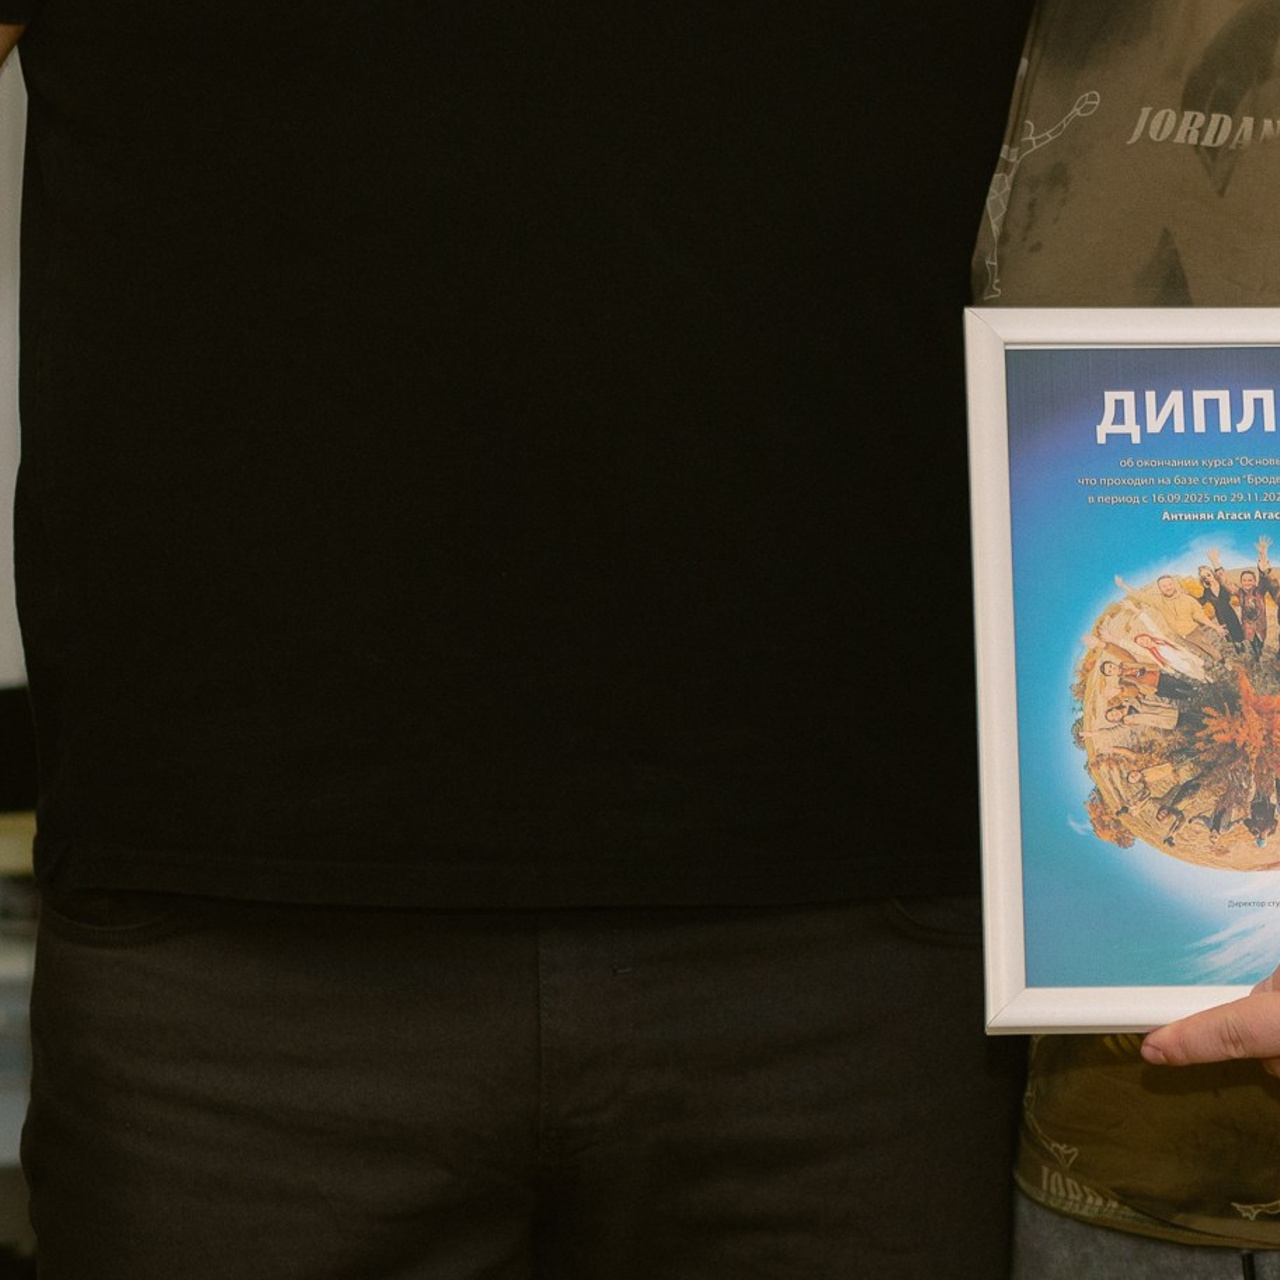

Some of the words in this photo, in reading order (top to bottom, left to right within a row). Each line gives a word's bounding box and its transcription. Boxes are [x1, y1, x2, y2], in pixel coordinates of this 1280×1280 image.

[1119, 457, 1135, 469] об
[1136, 458, 1199, 468] окончании
[1201, 458, 1234, 470] курса
[1077, 476, 1097, 486] что
[1099, 476, 1155, 488] проходил
[1157, 476, 1171, 486] на
[1173, 474, 1200, 486] базе
[1201, 474, 1242, 487] студии
[1087, 494, 1096, 504] в
[1097, 494, 1140, 506] период
[1141, 494, 1149, 504] с
[1151, 492, 1210, 504] 16.09.2025
[1213, 493, 1228, 503] по
[1162, 510, 1215, 521] Антинян
[1216, 510, 1252, 521] Агаси
